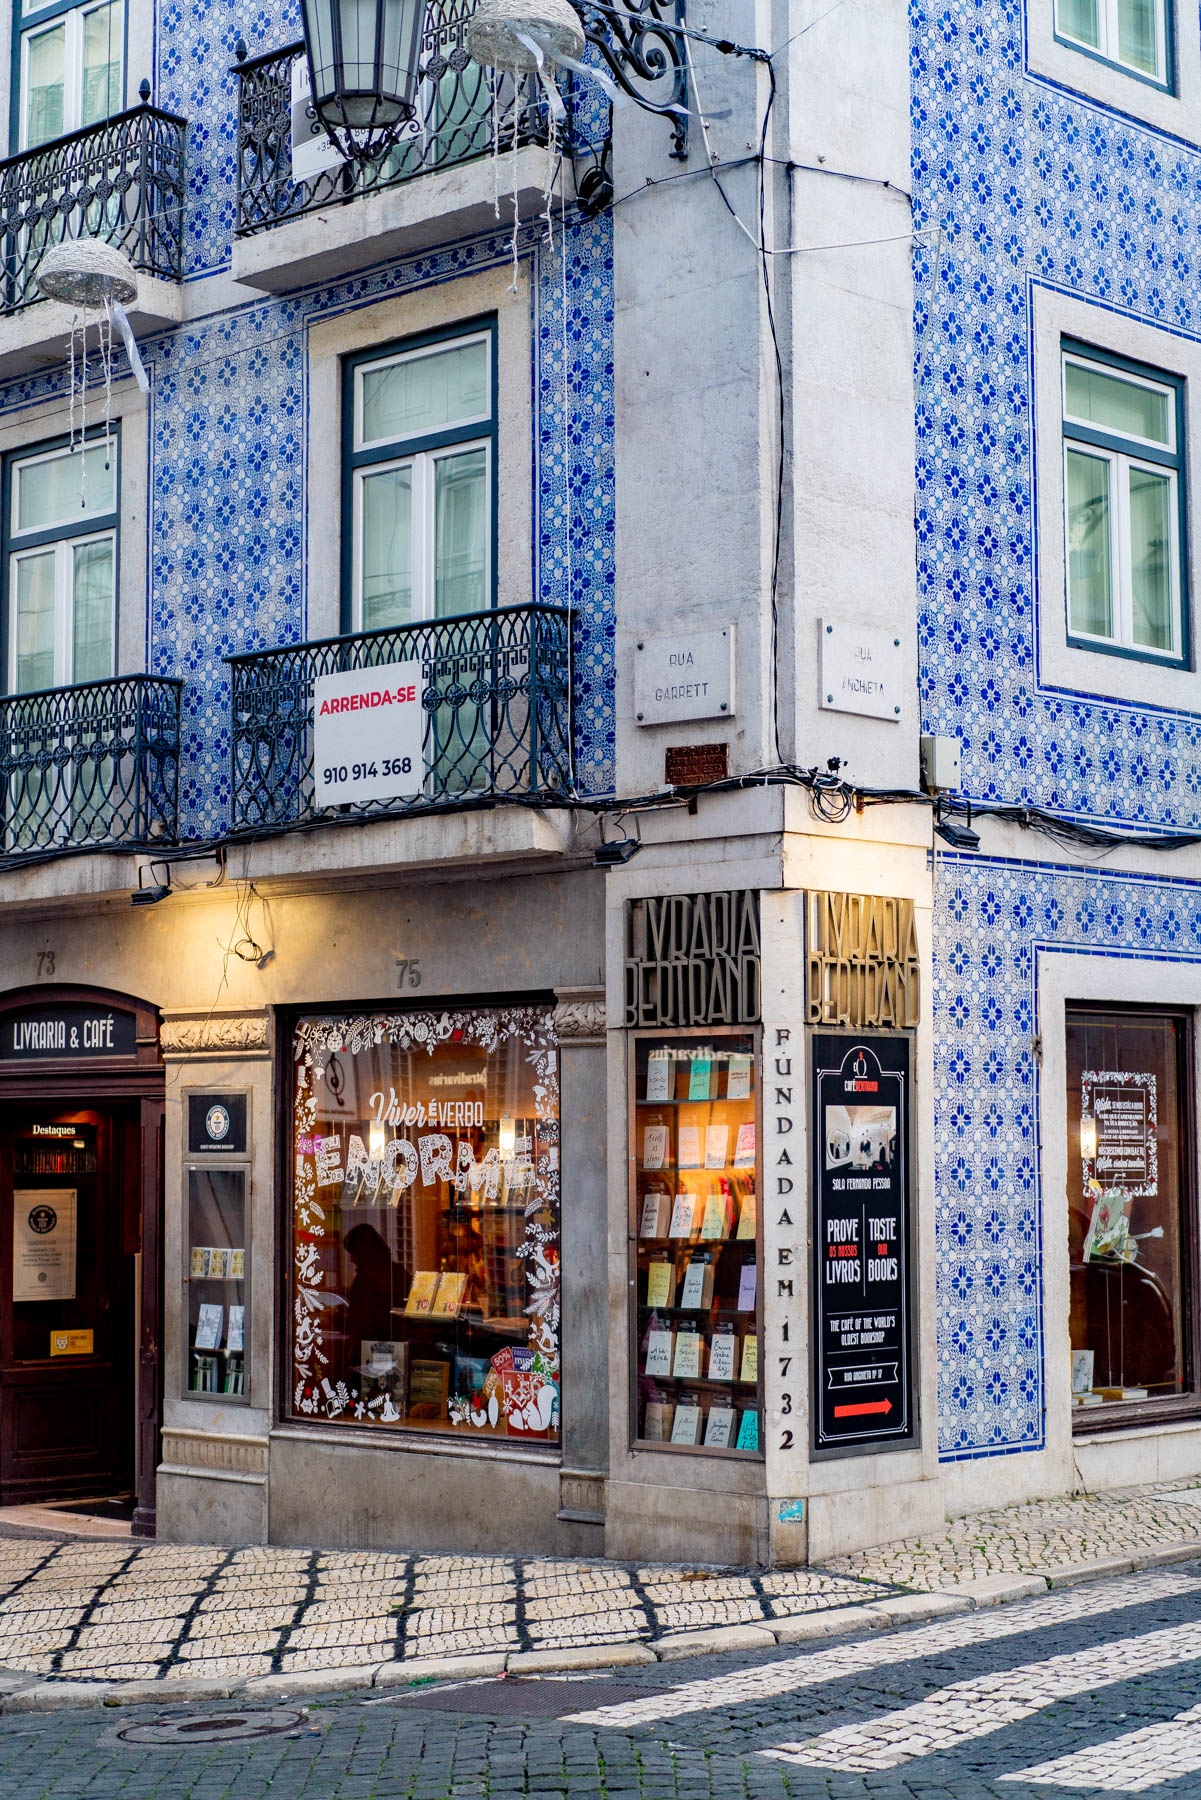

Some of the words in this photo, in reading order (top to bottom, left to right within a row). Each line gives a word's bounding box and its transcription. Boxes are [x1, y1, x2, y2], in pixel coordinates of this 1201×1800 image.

[669, 652, 694, 666] RUA
[854, 645, 872, 663] RUA
[655, 682, 709, 701] GARRETT
[842, 676, 884, 695] ANCHIETA
[319, 685, 416, 716] ARRENDA-SE
[323, 765, 348, 785] 910
[352, 761, 378, 781] 914
[382, 757, 412, 777] 368
[623, 889, 761, 963] LIVRARIA
[806, 890, 920, 963] LIVRARIA
[36, 950, 56, 977] 73
[395, 958, 421, 989] 75
[623, 955, 761, 1028] BERTRAND
[806, 956, 921, 1027] BERTRAND
[13, 1020, 66, 1050] LIVRARIA
[69, 1026, 80, 1049] &
[83, 1013, 114, 1049] CAFÉ
[369, 1087, 428, 1128] Viver
[428, 1098, 437, 1117] É
[438, 1101, 483, 1127] VERBO
[32, 1124, 76, 1138] Destaques
[774, 1028, 794, 1225] FUNDADA
[313, 1133, 536, 1200] ENORME
[832, 1178, 846, 1190] SALA
[846, 1178, 872, 1190] FERNANDO
[872, 1177, 891, 1190] PESSOA
[827, 1218, 859, 1243] PROVE
[868, 1217, 897, 1241] TASTE
[837, 1244, 858, 1257] NOSSOS
[877, 1243, 888, 1256] OUR
[826, 1259, 861, 1284] LIVROS
[868, 1257, 898, 1282] BOOKS
[830, 1319, 840, 1332] THE
[841, 1316, 854, 1331] CAFÉ
[855, 1318, 862, 1330] OF
[863, 1317, 873, 1329] THE
[874, 1315, 896, 1328] WORLD'S
[841, 1332, 859, 1346] OLDEST
[860, 1331, 885, 1345] BOOKSHOP
[493, 1351, 511, 1367] 50%
[486, 1373, 497, 1394] 40%
[778, 1319, 794, 1450] 1732
